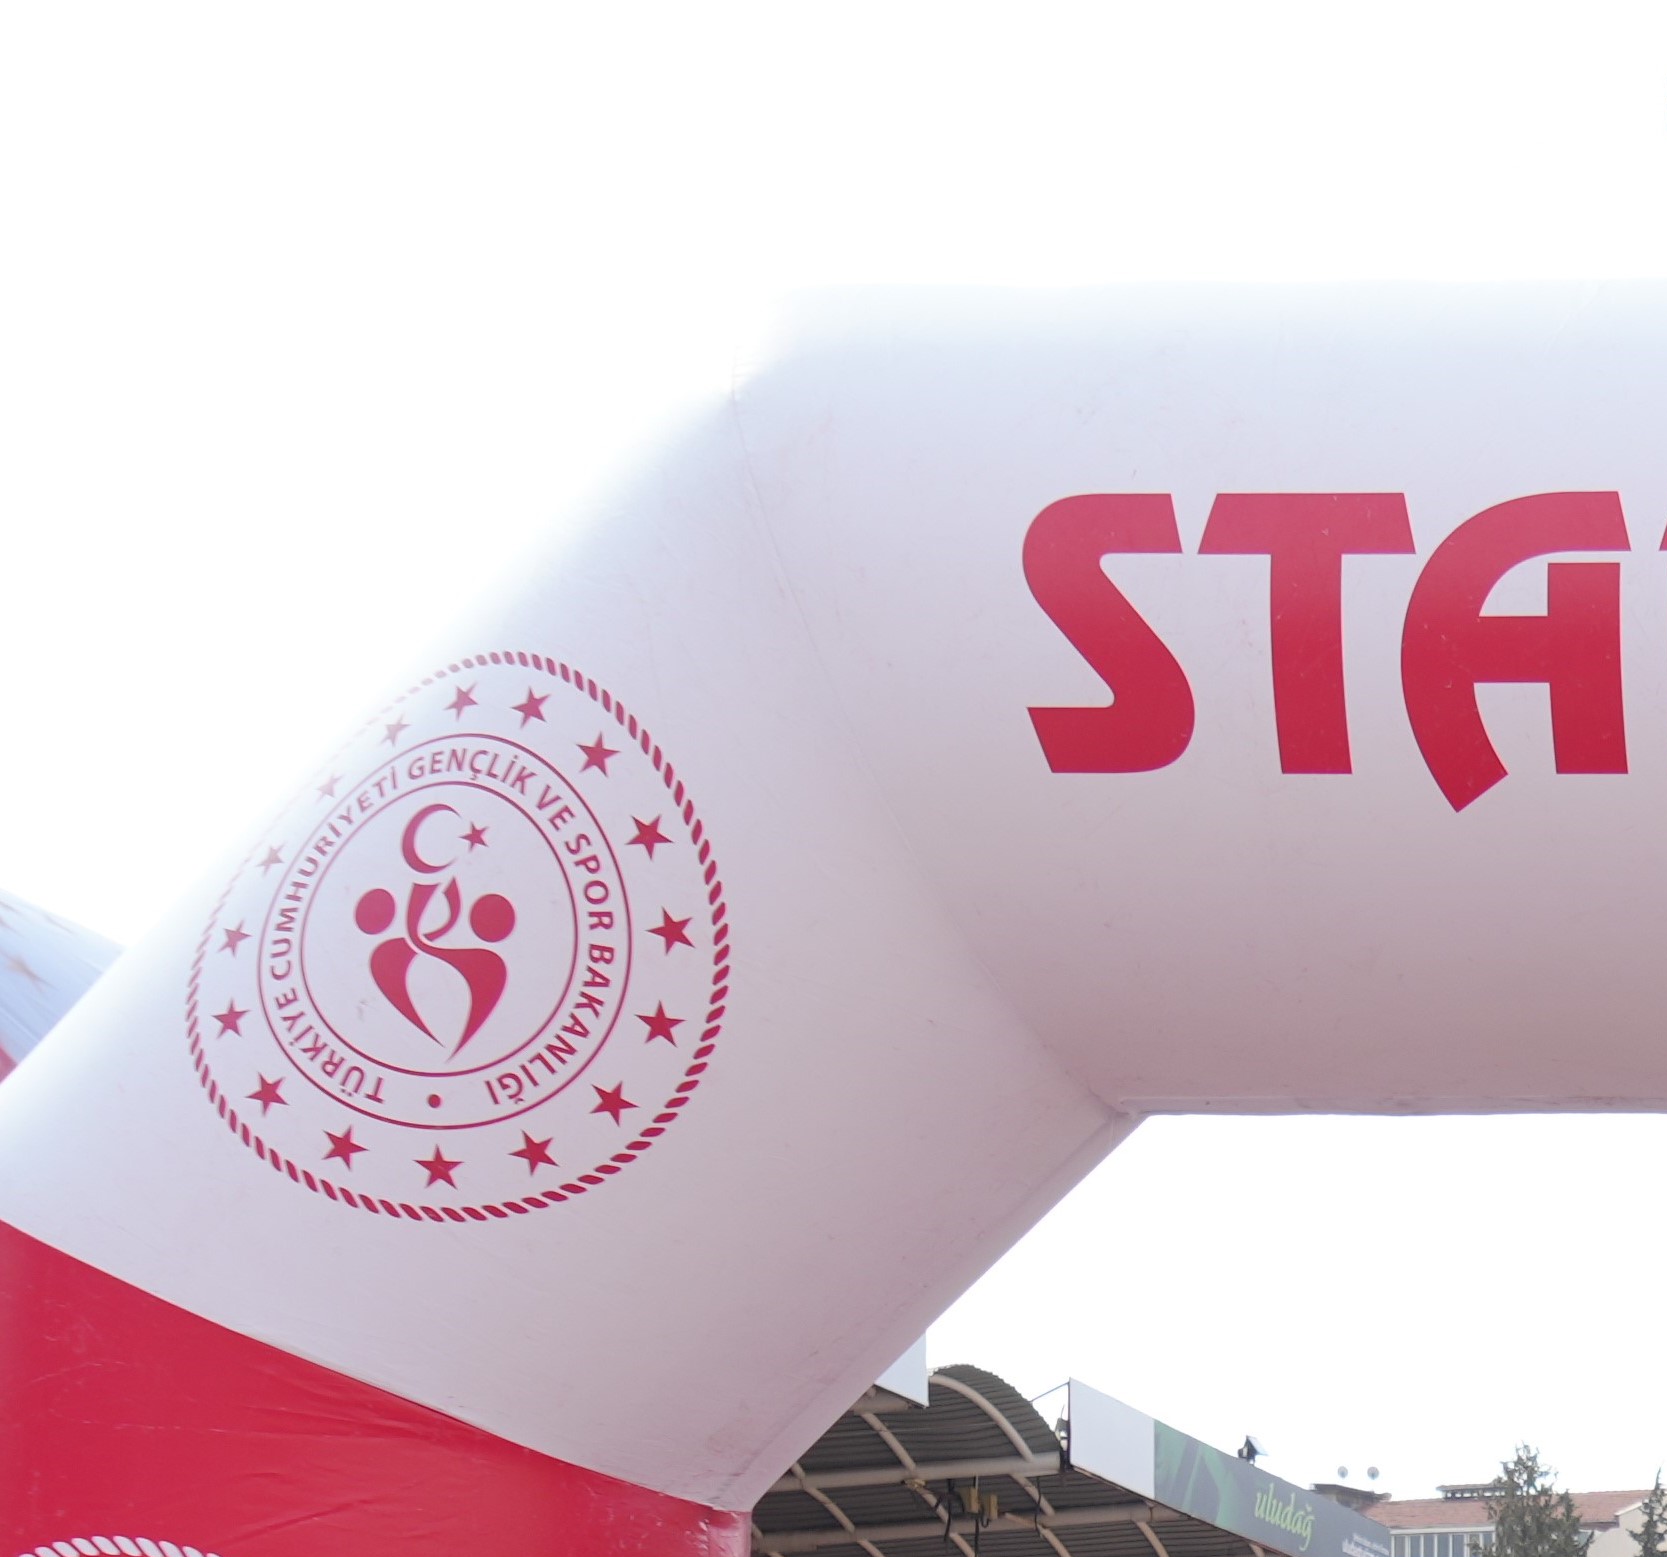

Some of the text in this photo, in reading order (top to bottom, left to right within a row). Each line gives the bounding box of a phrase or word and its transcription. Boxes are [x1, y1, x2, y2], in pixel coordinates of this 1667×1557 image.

[270, 747, 615, 1107] TÜRKİYE CUMHURİYETİ GENÇLİK VE SPOR BAKANLIĞI
[1255, 1482, 1316, 1552] uludağ
